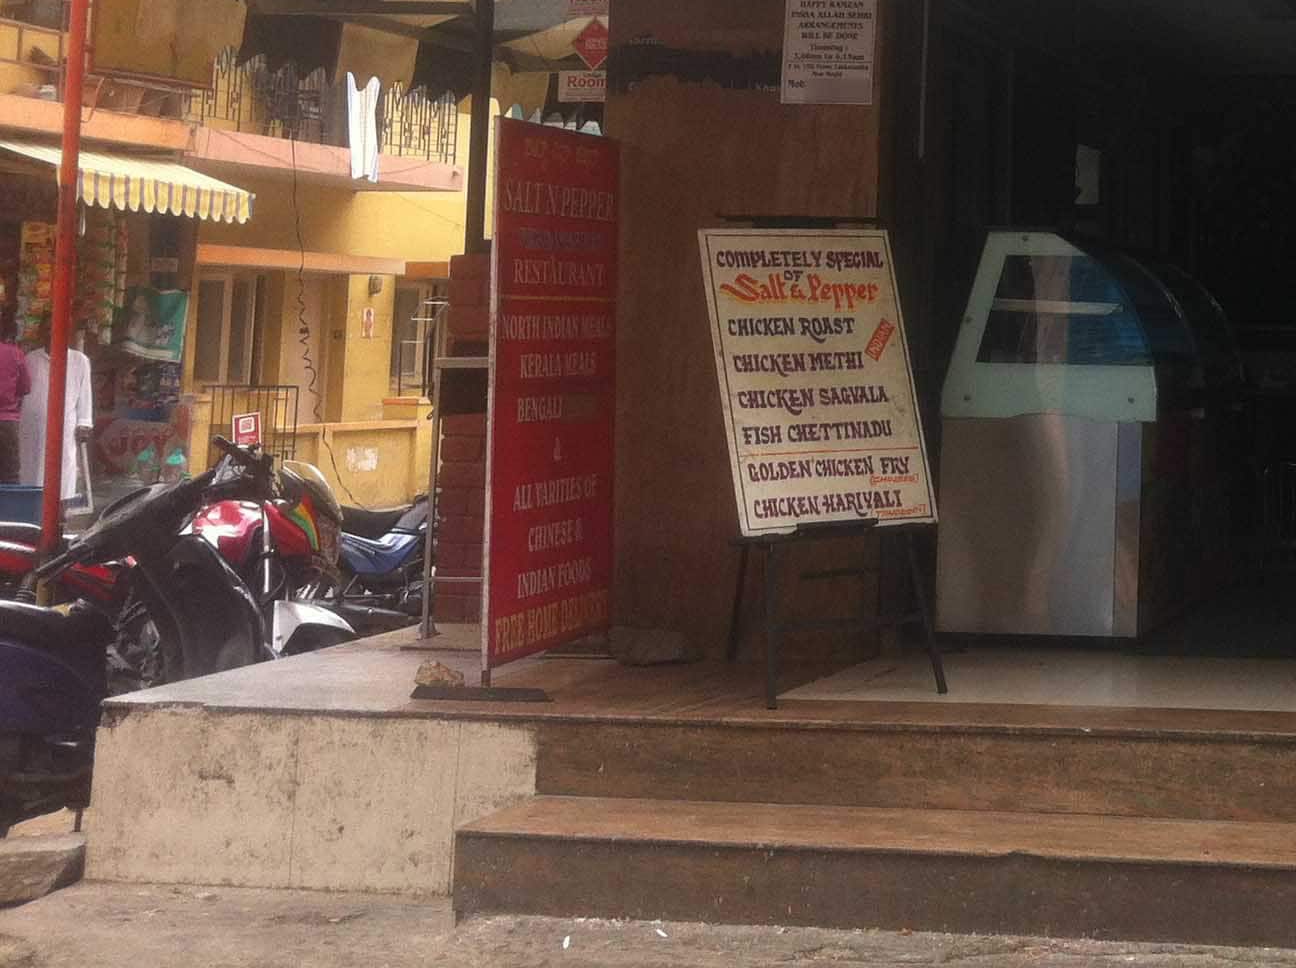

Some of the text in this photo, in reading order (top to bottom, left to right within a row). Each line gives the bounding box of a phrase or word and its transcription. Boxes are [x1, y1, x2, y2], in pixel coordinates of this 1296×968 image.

[513, 258, 607, 287] RESTAURANT
[716, 249, 883, 272] COMPLETELY SPECIAL
[784, 270, 803, 282] OF
[719, 272, 787, 303] Salt
[807, 272, 880, 311] Pepper
[728, 317, 856, 344] CHICKEN ROAST
[520, 353, 562, 379] KERALA
[732, 351, 865, 377] CHICKEN METHI
[518, 396, 562, 425] BENGALI
[737, 386, 815, 416] CHICKEN
[741, 419, 893, 445] FISH CHETTINADU
[747, 455, 910, 483] GOLDEN CHICKEN FRY
[512, 484, 533, 513] ALL
[753, 489, 903, 519] CHICKEN HARIYALI
[527, 520, 574, 553] CHINESE
[517, 566, 557, 600] INDIAN
[494, 612, 526, 655] FREE
